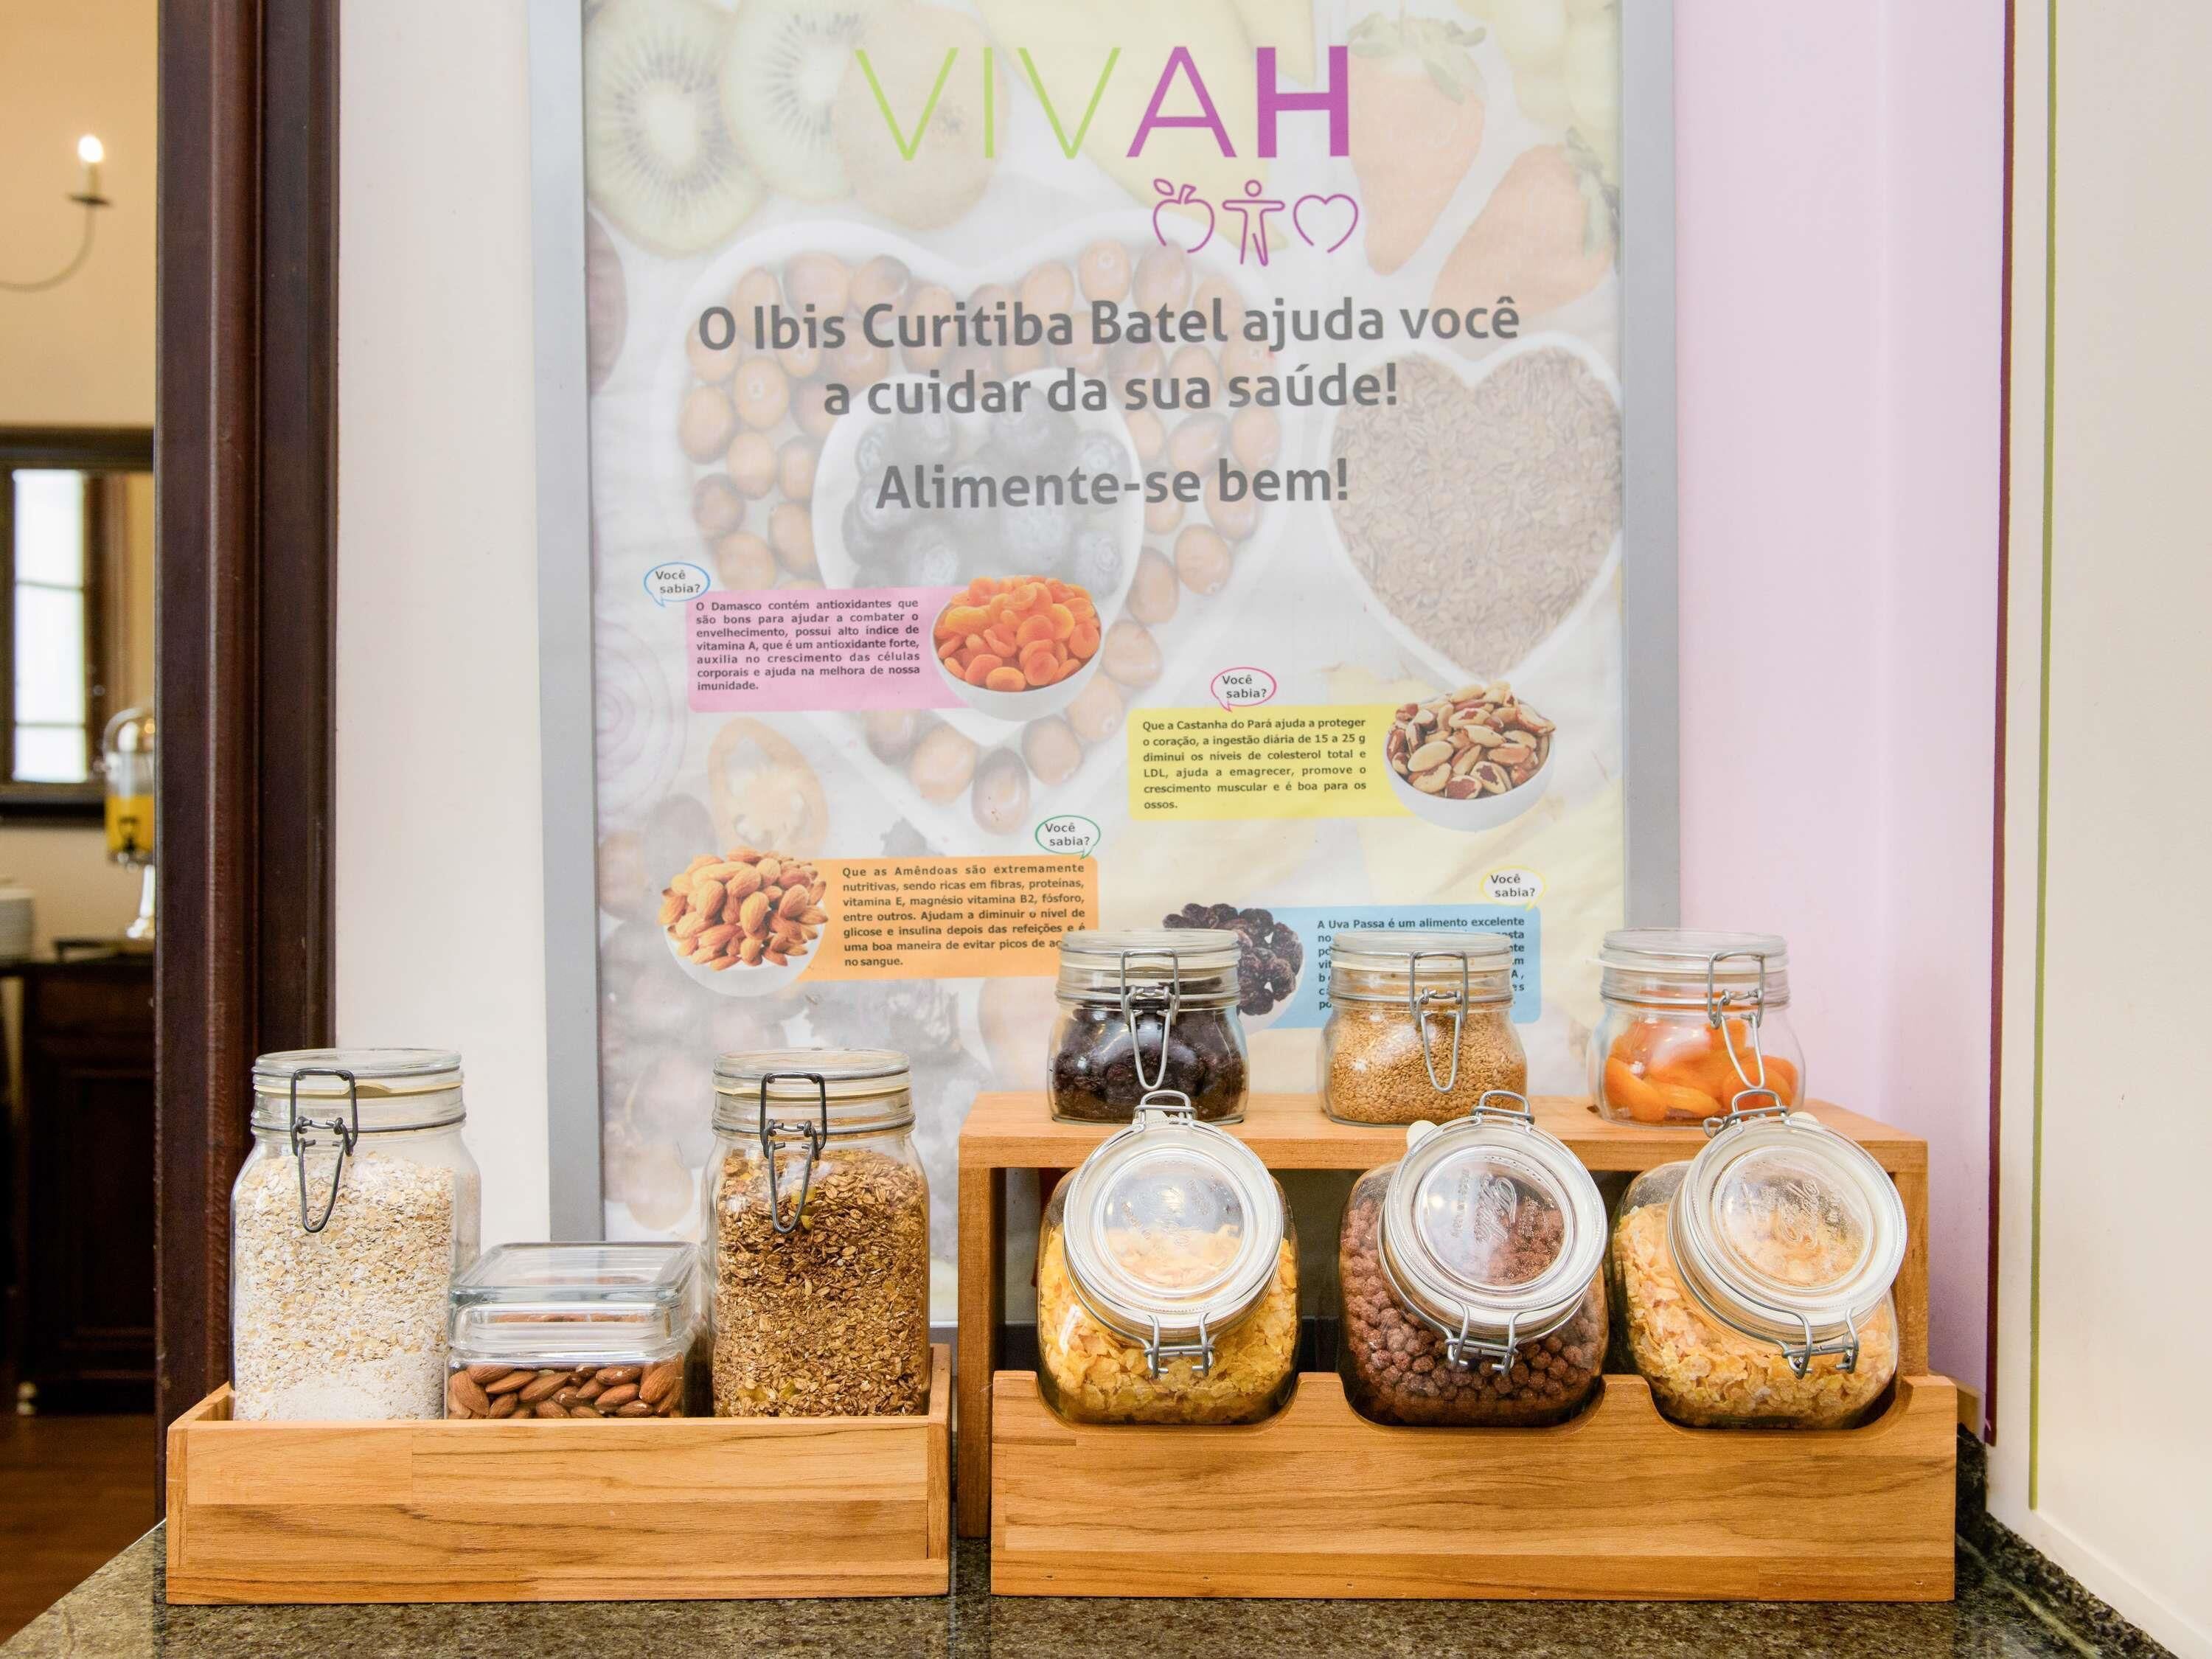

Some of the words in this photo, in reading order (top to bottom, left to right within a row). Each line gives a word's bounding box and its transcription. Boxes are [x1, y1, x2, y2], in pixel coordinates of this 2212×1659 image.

[854, 45, 1350, 161] VIVAH
[698, 306, 736, 351] O
[754, 303, 846, 350] Ibis
[862, 299, 1073, 349] Curitiba
[1091, 297, 1228, 349] Batel
[1242, 296, 1384, 347] ajuda
[1399, 295, 1520, 341] você
[824, 383, 850, 416] a
[868, 367, 1032, 415] cuidar
[1047, 366, 1107, 413] da
[1124, 377, 1211, 411] sua
[1228, 362, 1397, 409] saúde!
[875, 461, 1200, 509] Alimente-se
[1218, 456, 1348, 503] bem!
[655, 569, 686, 580] Você
[660, 582, 701, 594] sabia?
[696, 602, 705, 611] O
[712, 601, 762, 611] Damasco
[768, 599, 810, 611] contém
[816, 599, 891, 610] antioxidantes
[898, 600, 919, 610] que
[696, 614, 716, 625] são
[723, 614, 751, 625] bons
[758, 616, 785, 626] para
[791, 613, 830, 625] ajudar
[849, 612, 905, 622] combater
[696, 627, 788, 639] envelhecimento,
[796, 626, 831, 639] possui
[838, 626, 859, 636] alto
[866, 625, 900, 636] índice
[905, 625, 919, 635] de
[696, 641, 745, 651] vitamina
[748, 641, 759, 652] A,
[762, 642, 783, 653] que
[786, 639, 793, 650] é
[796, 641, 813, 650] um
[816, 639, 886, 650] antioxidante
[889, 638, 919, 650] forte,
[697, 654, 738, 664] auxilia
[767, 653, 843, 664] crescimento
[849, 652, 870, 662] das
[877, 650, 920, 661] células
[697, 667, 749, 680] corporais
[765, 667, 796, 678] ajuda
[801, 668, 815, 676] na
[820, 666, 865, 676] melhora
[870, 665, 883, 675] de
[888, 667, 920, 675] nossa
[698, 681, 759, 691] imunidade.
[1222, 675, 1253, 686] Você
[1226, 688, 1267, 699] sabia?
[1142, 720, 1165, 733] Que
[1176, 719, 1228, 730] Castanha
[1230, 719, 1245, 729] do
[1247, 718, 1272, 728] Pará
[1275, 717, 1306, 731] ajuda
[1308, 720, 1315, 728] a
[1318, 717, 1366, 730] proteger
[1152, 736, 1200, 749] coração,
[1213, 734, 1260, 747] ingestão
[1262, 734, 1295, 744] diária
[1298, 734, 1312, 744] de
[1315, 734, 1329, 743] 15
[1332, 735, 1338, 743] a
[1342, 733, 1355, 743] 25
[1359, 734, 1366, 745] g
[1143, 751, 1185, 762] diminui
[1191, 754, 1203, 762] os
[1209, 751, 1242, 761] níveis
[1248, 751, 1262, 760] de
[1267, 749, 1321, 760] colesterol
[1327, 748, 1353, 759] total
[1359, 751, 1366, 759] e
[1144, 768, 1169, 779] LDL,
[1176, 767, 1208, 779] ajuda
[1229, 768, 1295, 779] emagrecer,
[1301, 766, 1353, 777] promove
[1144, 783, 1211, 794] crescimento
[1217, 782, 1267, 793] muscular
[1273, 784, 1280, 792] e
[1285, 781, 1292, 791] é
[1298, 781, 1318, 791] boa
[1324, 782, 1348, 793] para
[1354, 782, 1366, 790] os
[1144, 801, 1178, 810] ossos.
[1045, 822, 1076, 833] Você
[1049, 835, 1091, 847] sabia?
[842, 867, 866, 879] Que
[874, 869, 887, 877] as
[894, 865, 958, 876] Amêndoas
[965, 864, 987, 874] são
[993, 863, 1084, 874] extremamente
[843, 881, 899, 894] nutritivas,
[902, 880, 936, 891] sendo
[940, 880, 966, 890] ricas
[969, 882, 987, 890] em
[990, 879, 1025, 891] fibras,
[1029, 877, 1084, 891] proteínas,
[1490, 873, 1521, 884] Você
[1495, 887, 1536, 898] sabia?
[843, 896, 891, 907] vitamina
[896, 897, 905, 908] E,
[910, 894, 964, 908] magnésio
[967, 894, 1016, 905] vitamina
[1020, 894, 1037, 905] B2,
[1042, 892, 1085, 905] fósforo,
[843, 912, 873, 922] entre
[877, 911, 916, 922] outros.
[920, 910, 963, 922] Ajudam
[967, 912, 974, 920] a
[978, 908, 1026, 919] diminuir
[1040, 908, 1067, 919] nível
[1071, 908, 1085, 918] de
[1317, 920, 1326, 929] A
[1329, 919, 1349, 929] Uva
[1353, 919, 1385, 929] Passa
[1388, 917, 1395, 929] é
[1398, 920, 1416, 928] um
[1419, 917, 1468, 928] alimento
[1471, 916, 1525, 927] excelente
[844, 927, 883, 939] glicose
[887, 928, 894, 936] e
[898, 925, 942, 936] insulina
[947, 925, 983, 937] depois
[987, 924, 1007, 934] das
[1012, 922, 1062, 936] refeições
[844, 944, 868, 952] uma
[872, 942, 892, 951] boa
[897, 940, 942, 950] maneira
[945, 940, 959, 950] de
[963, 939, 996, 950] evitar
[999, 938, 1028, 950] picos
[1032, 938, 1046, 948] de
[844, 959, 859, 967] no
[860, 958, 903, 968] sangue.
